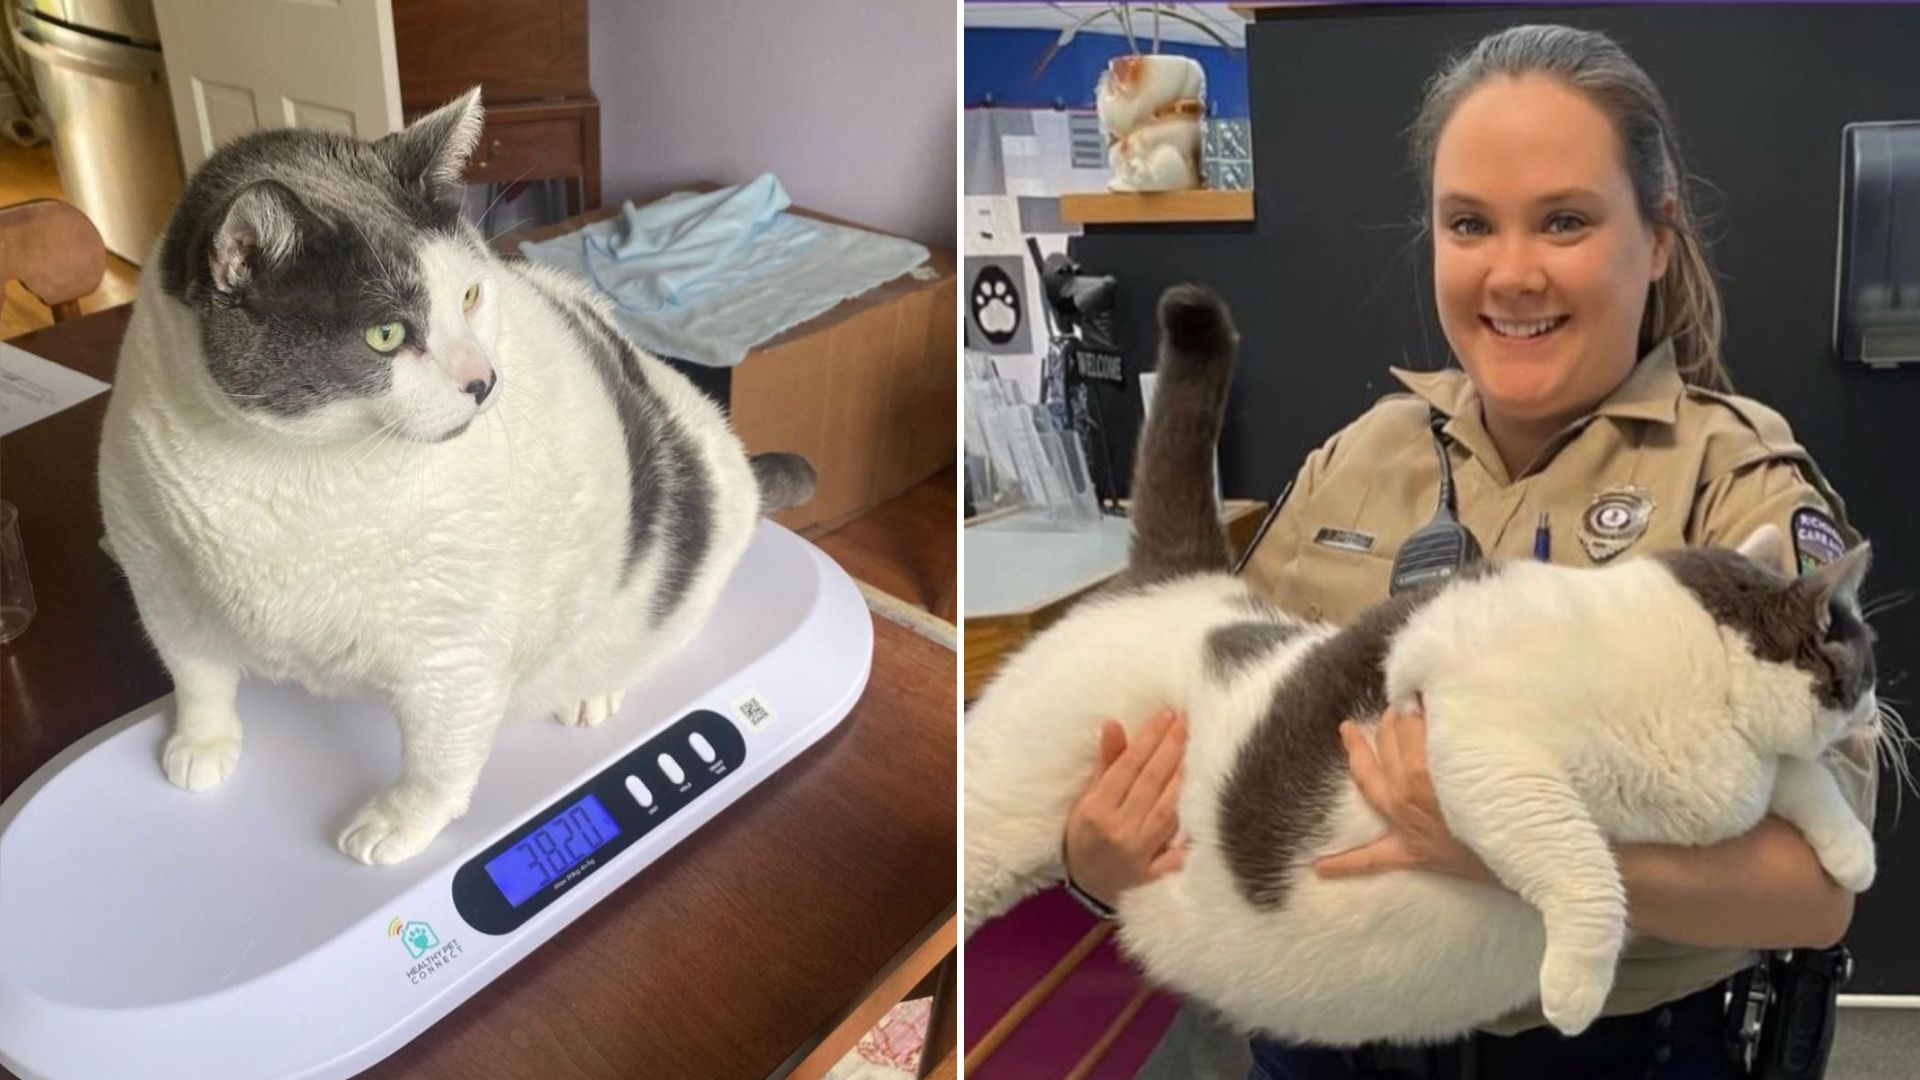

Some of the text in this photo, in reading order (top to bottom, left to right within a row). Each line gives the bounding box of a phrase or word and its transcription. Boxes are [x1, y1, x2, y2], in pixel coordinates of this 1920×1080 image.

[1076, 351, 1122, 381] WELCOME
[406, 939, 459, 979] HEALTHY PET
[411, 946, 463, 985] CONNECT
